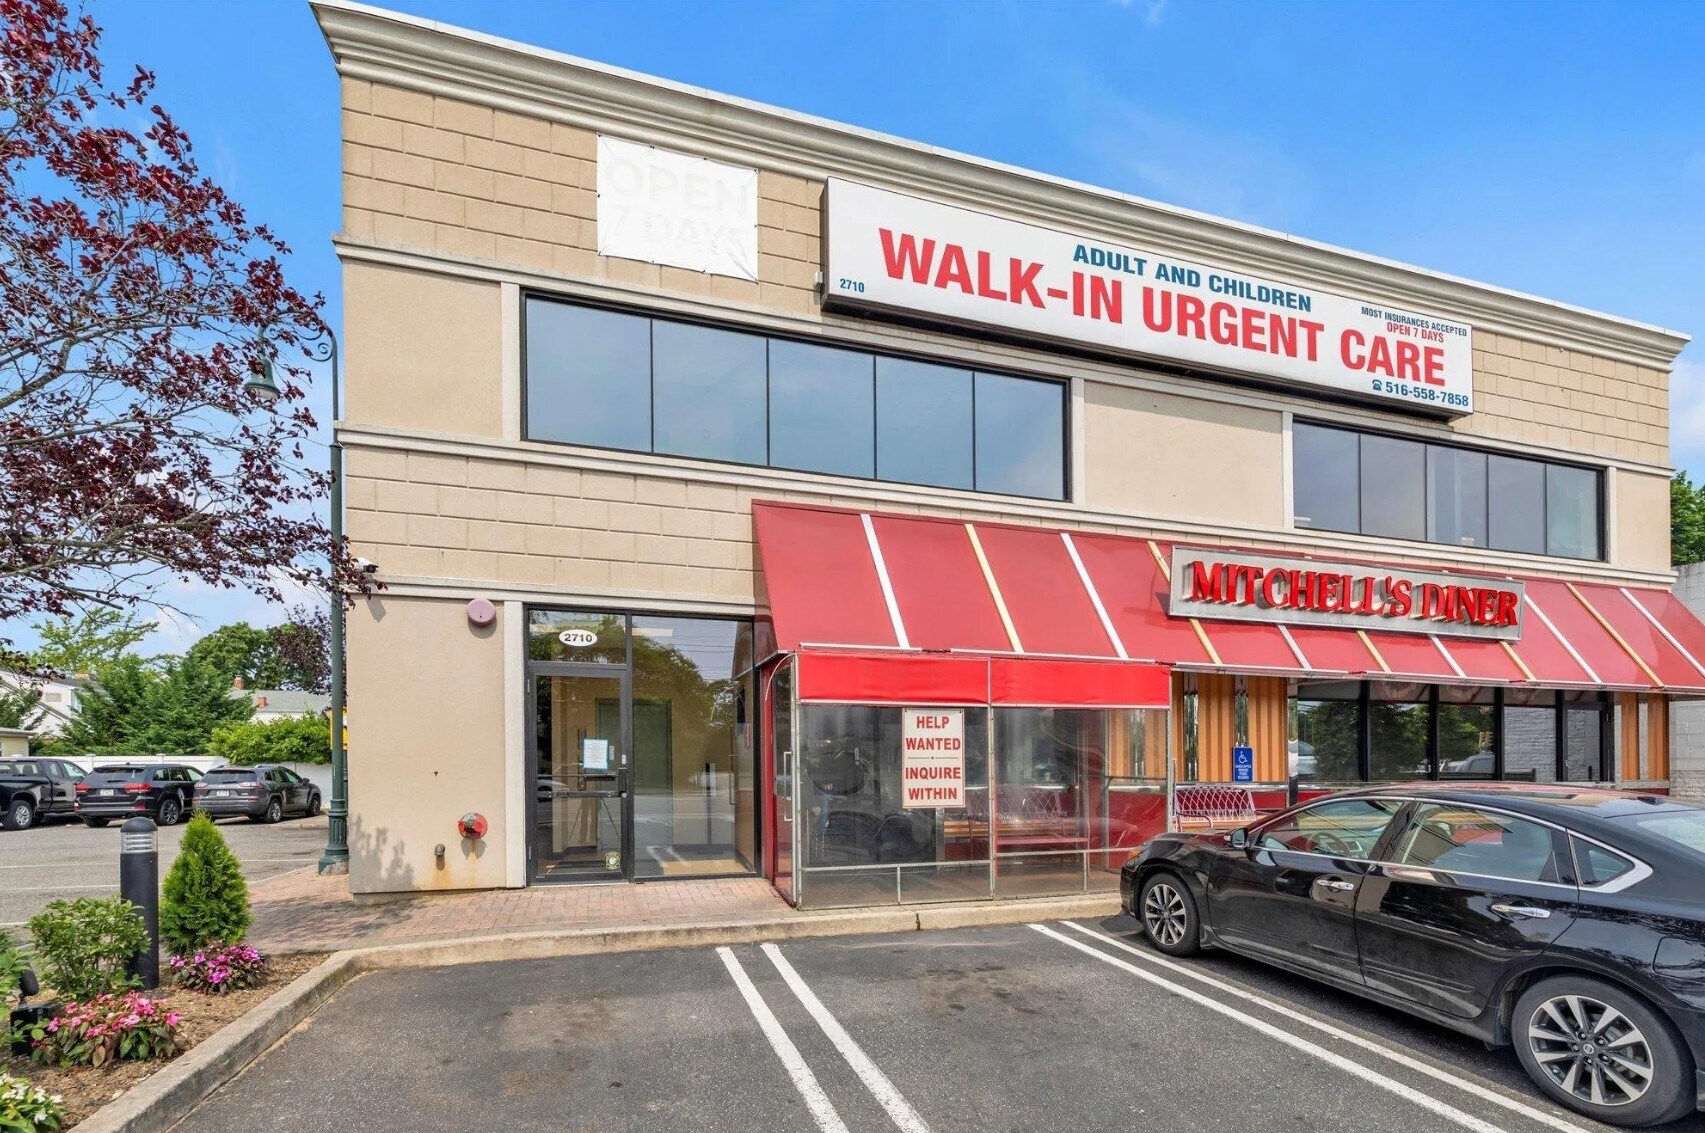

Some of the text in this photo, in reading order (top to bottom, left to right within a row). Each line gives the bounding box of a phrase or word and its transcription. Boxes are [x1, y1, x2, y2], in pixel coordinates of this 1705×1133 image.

[605, 158, 749, 218] OPEN
[609, 202, 631, 239] 7
[839, 278, 865, 293] 2710
[1073, 244, 1312, 312] ADULT AND CHILDREN
[879, 228, 1445, 387] WALK-IN URGENT CARE
[1361, 306, 1467, 337] MOST INSURANCES ACCEPTED
[1386, 321, 1444, 343] OPEN 7 DAYS
[1385, 381, 1469, 407] 516-558-7858
[1189, 560, 1519, 626] MITCHELL'S DINER
[563, 633, 593, 643] 2710
[916, 715, 950, 729] HELP
[905, 737, 961, 751] WANTED
[905, 766, 961, 780] INQUIRE
[908, 787, 957, 800] WITHIN
